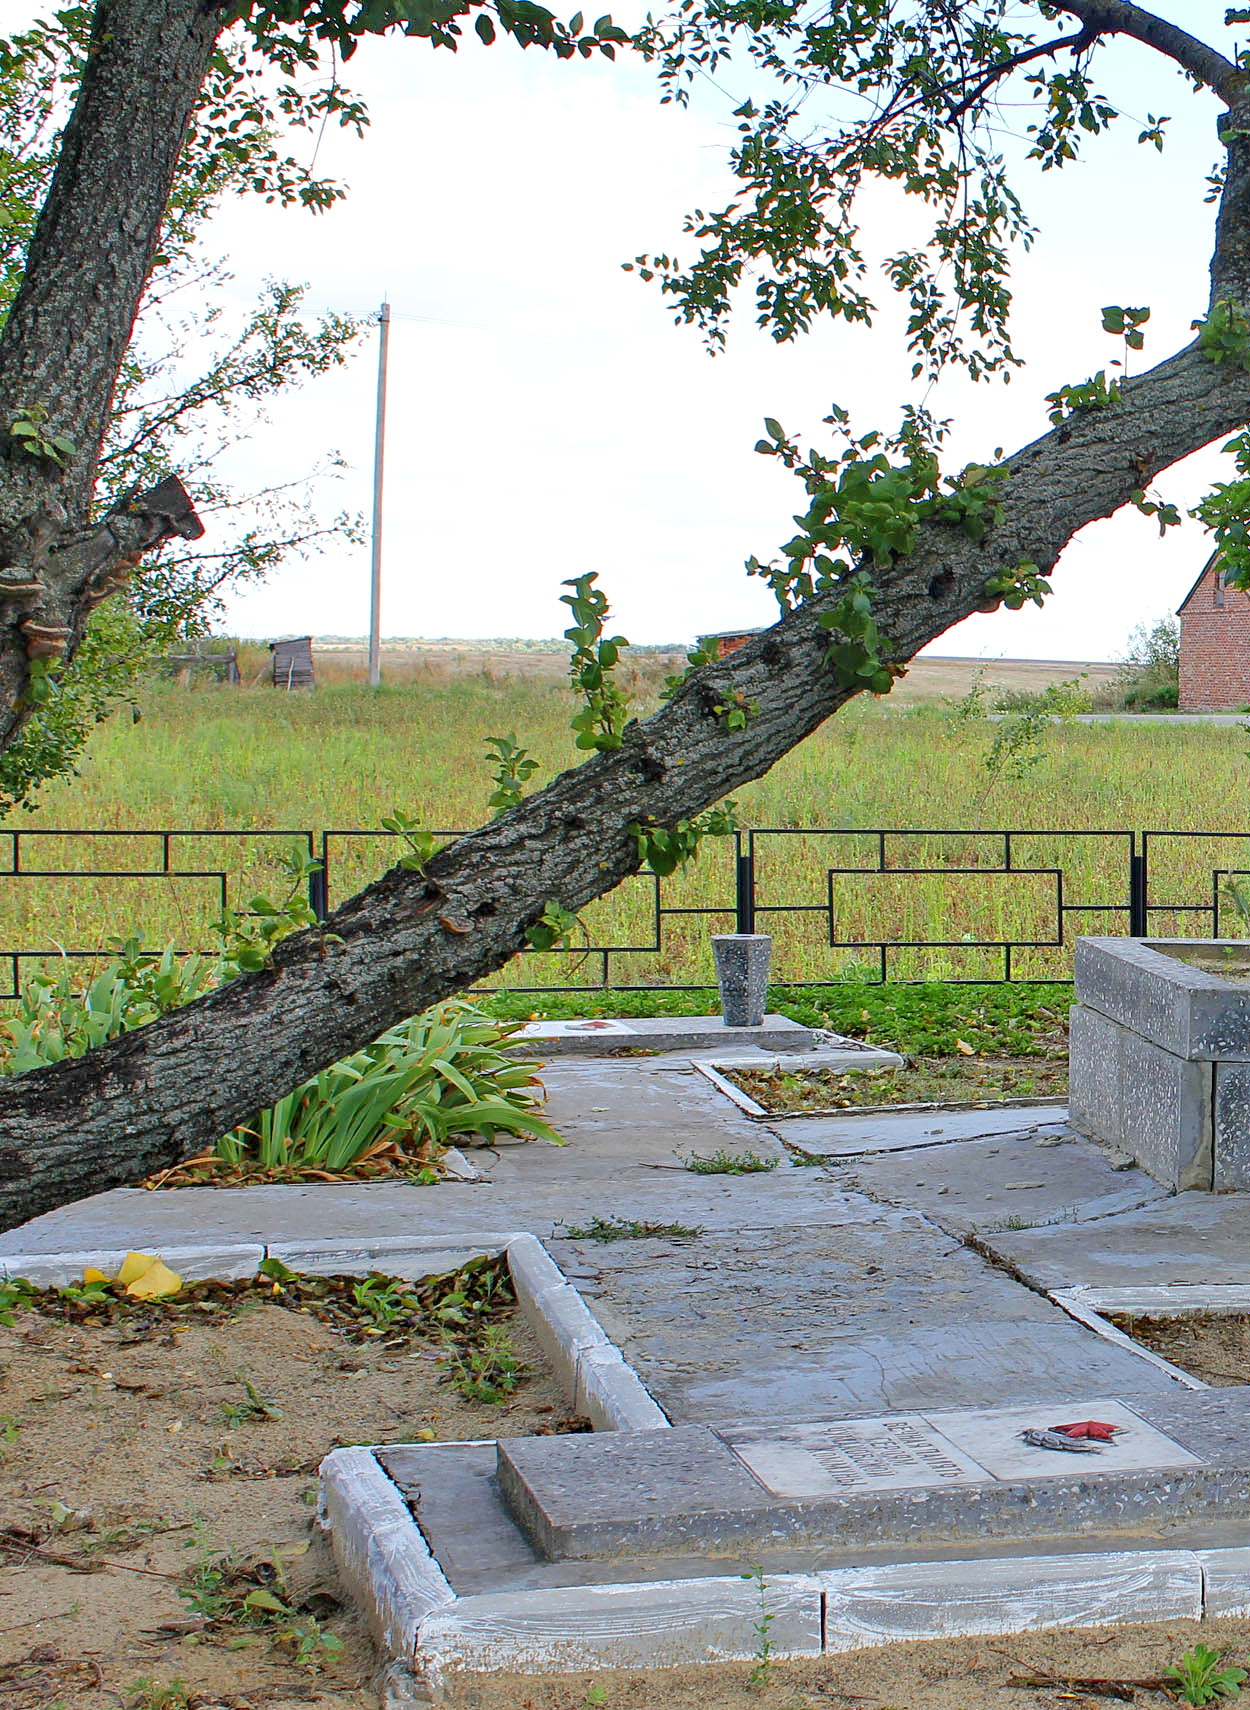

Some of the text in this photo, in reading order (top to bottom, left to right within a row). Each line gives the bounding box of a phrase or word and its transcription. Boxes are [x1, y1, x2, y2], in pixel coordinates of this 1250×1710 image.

[804, 1447, 868, 1486] КОММУНЫ
[818, 1426, 899, 1477] ЧУМАКОВСКОЙ
[864, 1437, 919, 1466] ГЕРОЯМ
[882, 1421, 967, 1477] ВЕЧНАЯ ПАМЯТЬ
